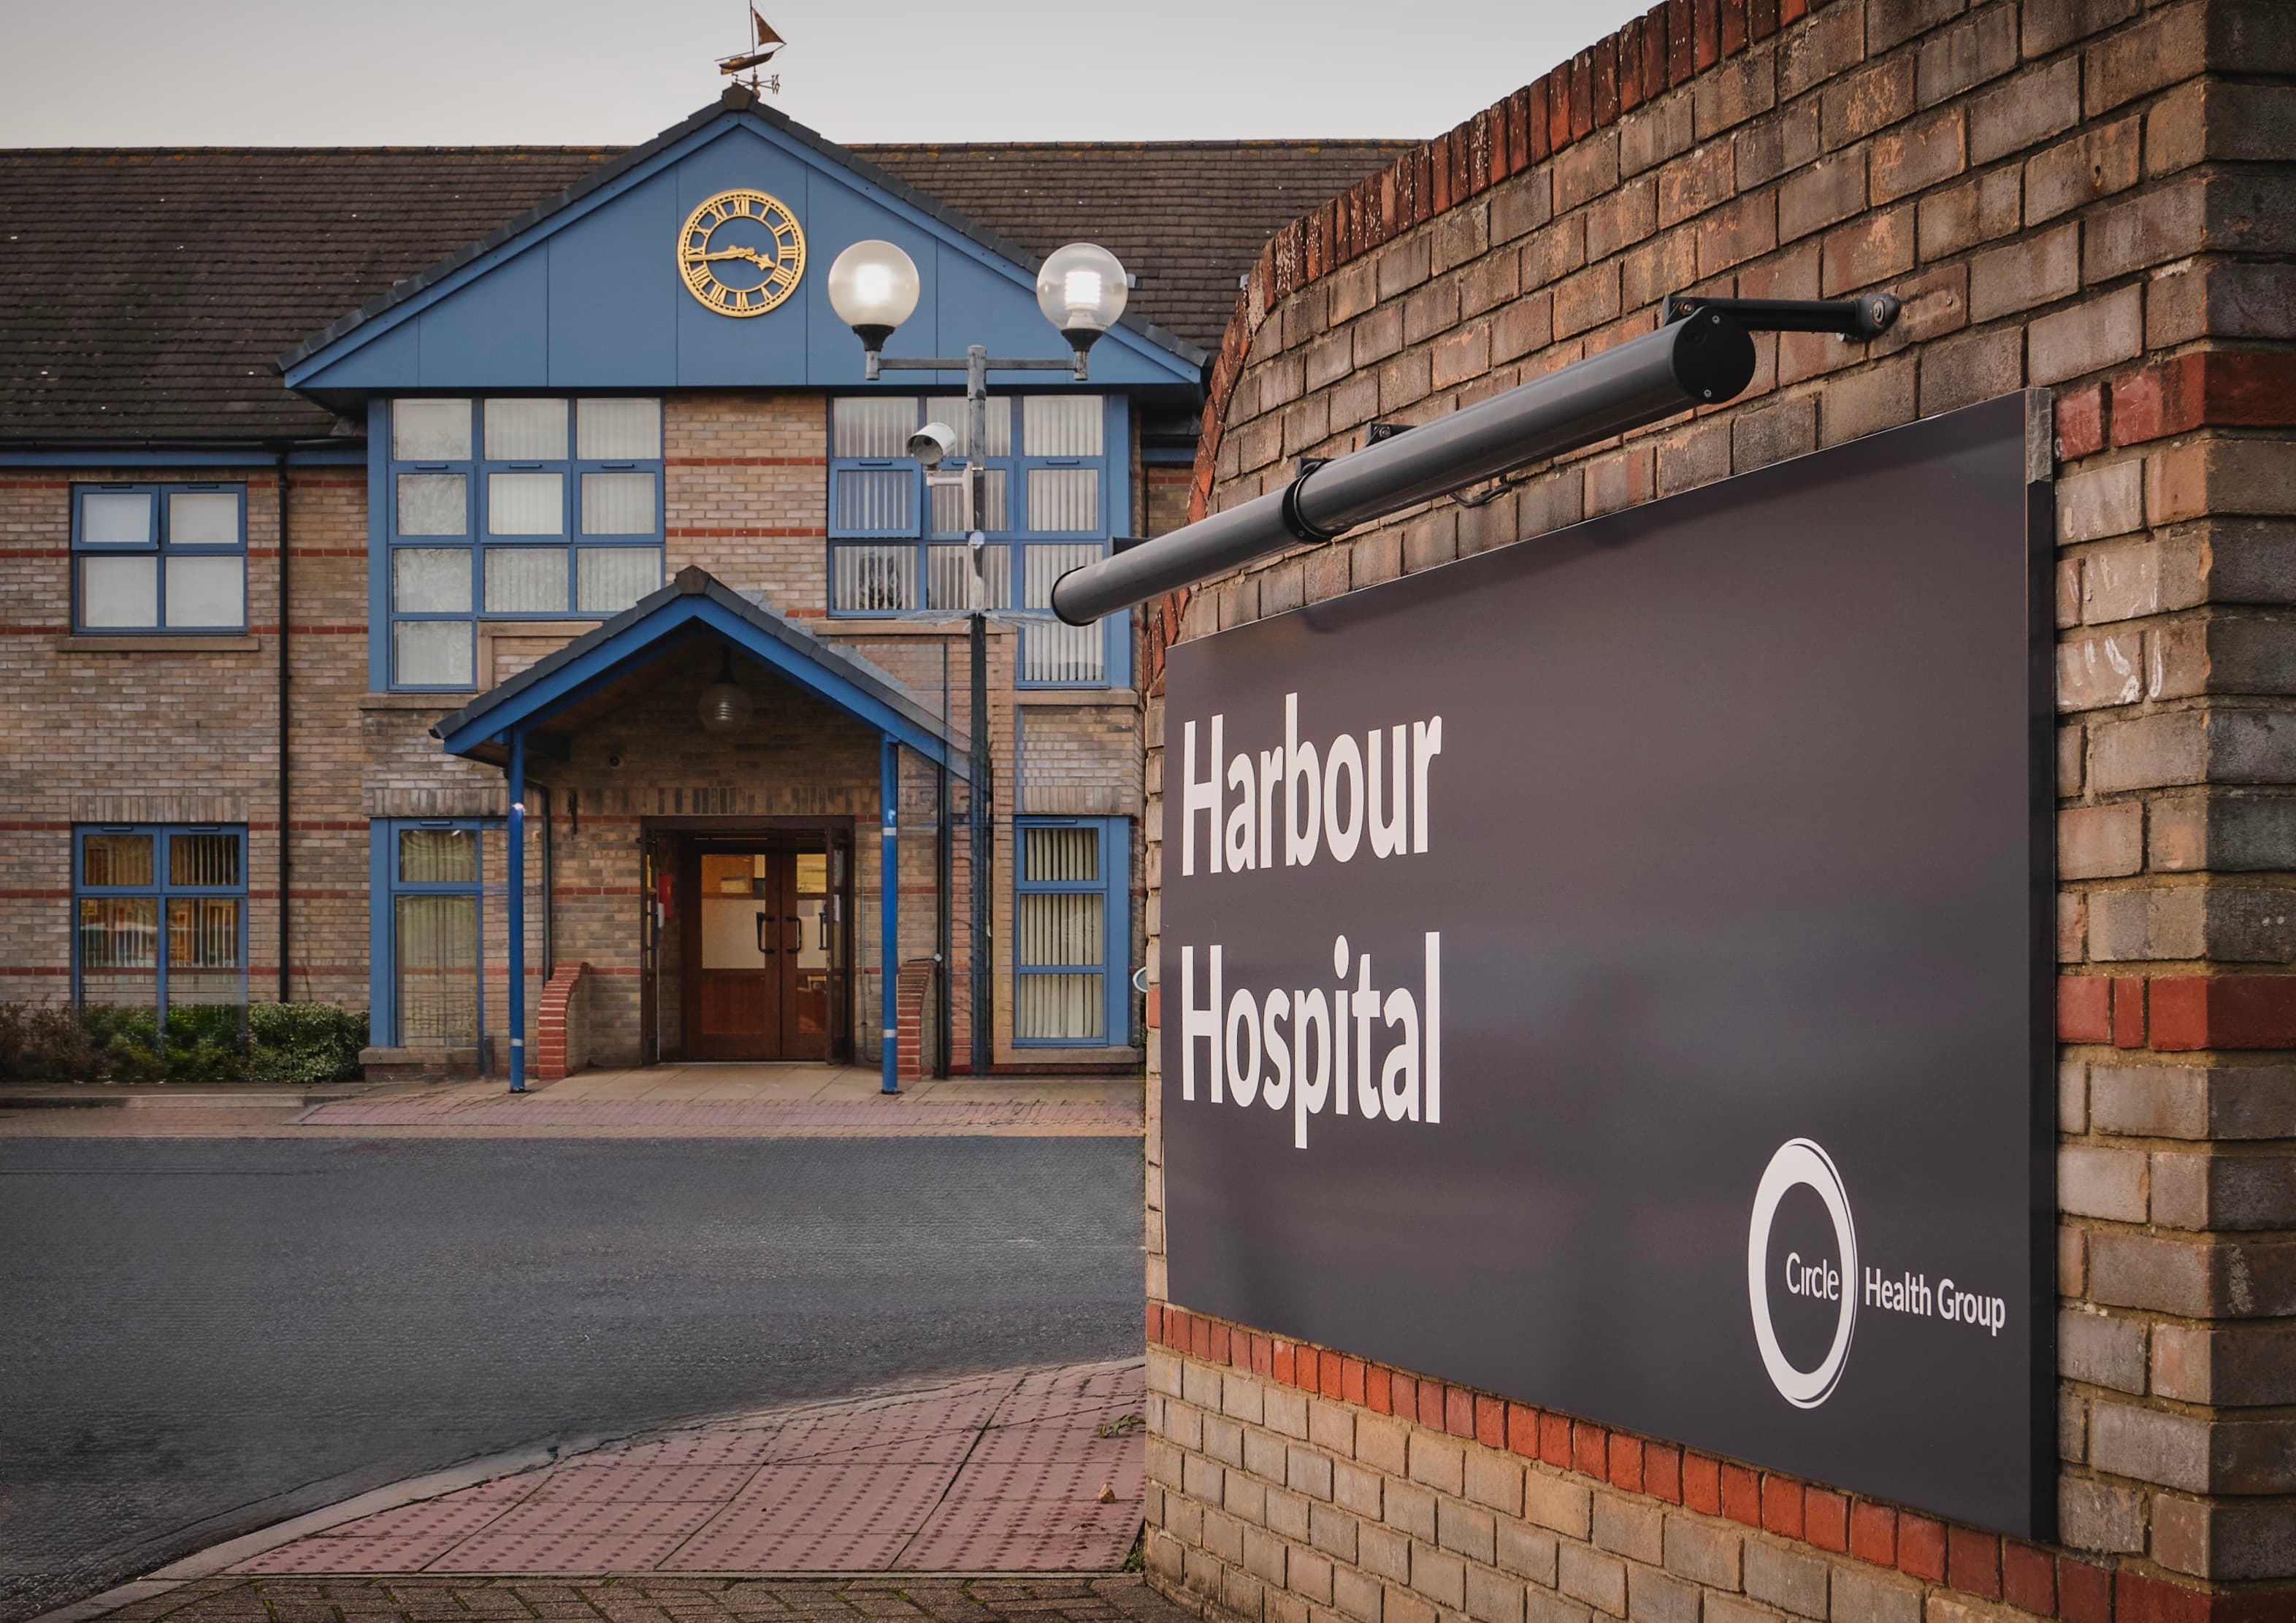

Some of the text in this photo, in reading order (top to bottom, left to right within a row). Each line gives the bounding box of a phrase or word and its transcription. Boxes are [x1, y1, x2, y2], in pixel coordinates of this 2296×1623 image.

[1182, 692, 1442, 877] Harbour
[1182, 931, 1441, 1149] Hospital
[1786, 1251, 2006, 1337] Circle Health Group
